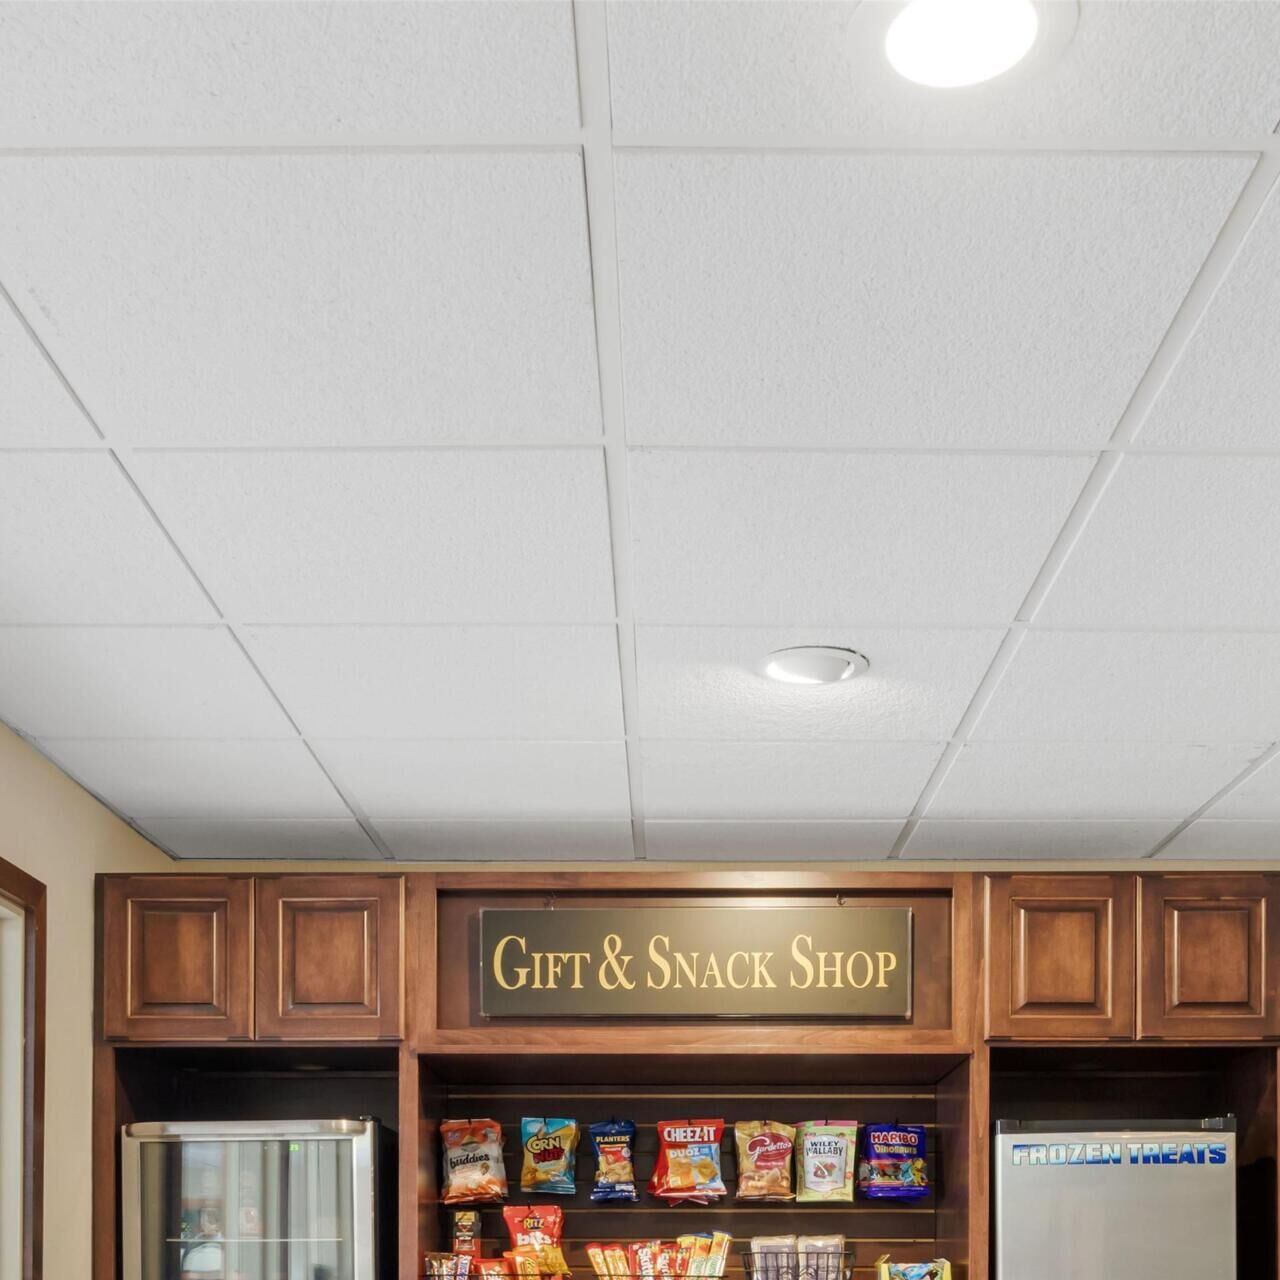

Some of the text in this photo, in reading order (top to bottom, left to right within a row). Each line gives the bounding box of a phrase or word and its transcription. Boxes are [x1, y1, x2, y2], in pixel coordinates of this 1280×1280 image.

[598, 933, 636, 991] &
[526, 1135, 562, 1154] CORN
[595, 1135, 631, 1144] PLANTERS
[809, 1140, 841, 1148] WILEY
[871, 1131, 919, 1145] HARIBO
[805, 1146, 845, 1158] WALLABY
[1012, 1142, 1228, 1166] FROZEN TREATS
[449, 1153, 491, 1170] buddies
[523, 1217, 545, 1230] RITZ
